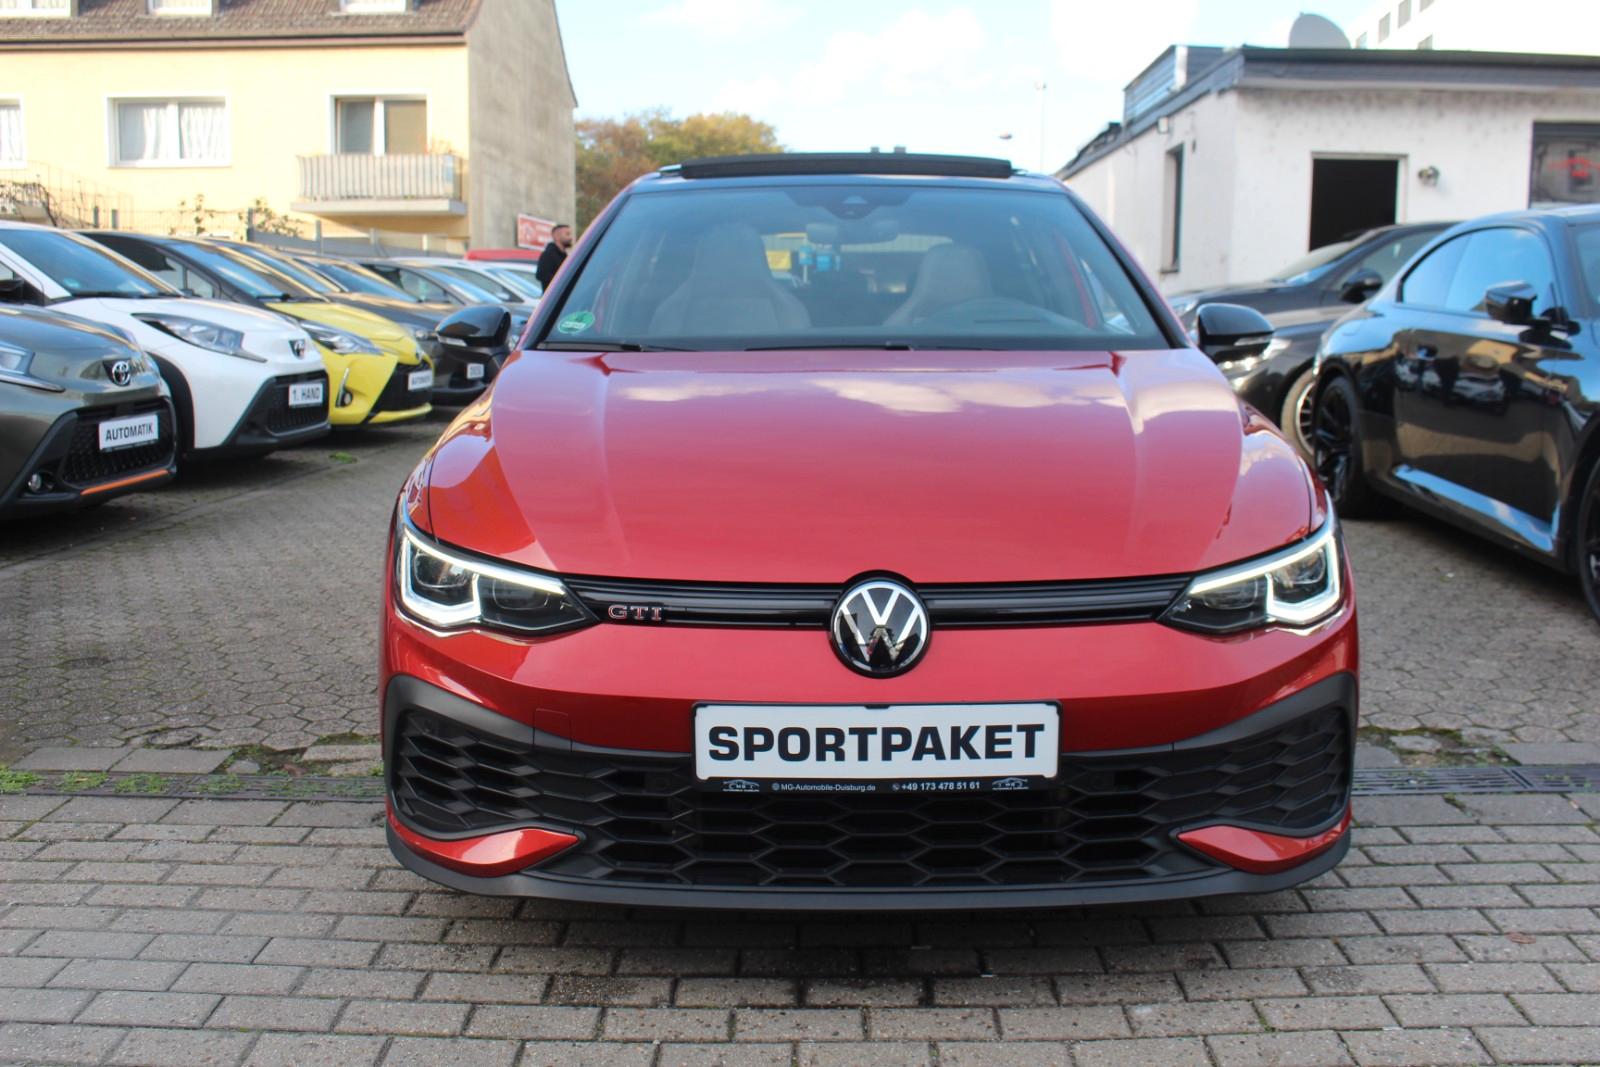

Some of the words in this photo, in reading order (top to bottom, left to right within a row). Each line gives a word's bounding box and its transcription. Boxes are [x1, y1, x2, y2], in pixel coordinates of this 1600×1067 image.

[105, 422, 153, 442] AUTOMATIK
[607, 604, 662, 621] GTI
[708, 724, 1045, 762] SPORTPAKET
[780, 783, 876, 792] MG-Automobile-Duisburg.de
[901, 783, 918, 791] +49
[920, 783, 936, 791] 173
[938, 782, 954, 790] 478
[956, 782, 967, 790] 51
[969, 781, 980, 790] 61
